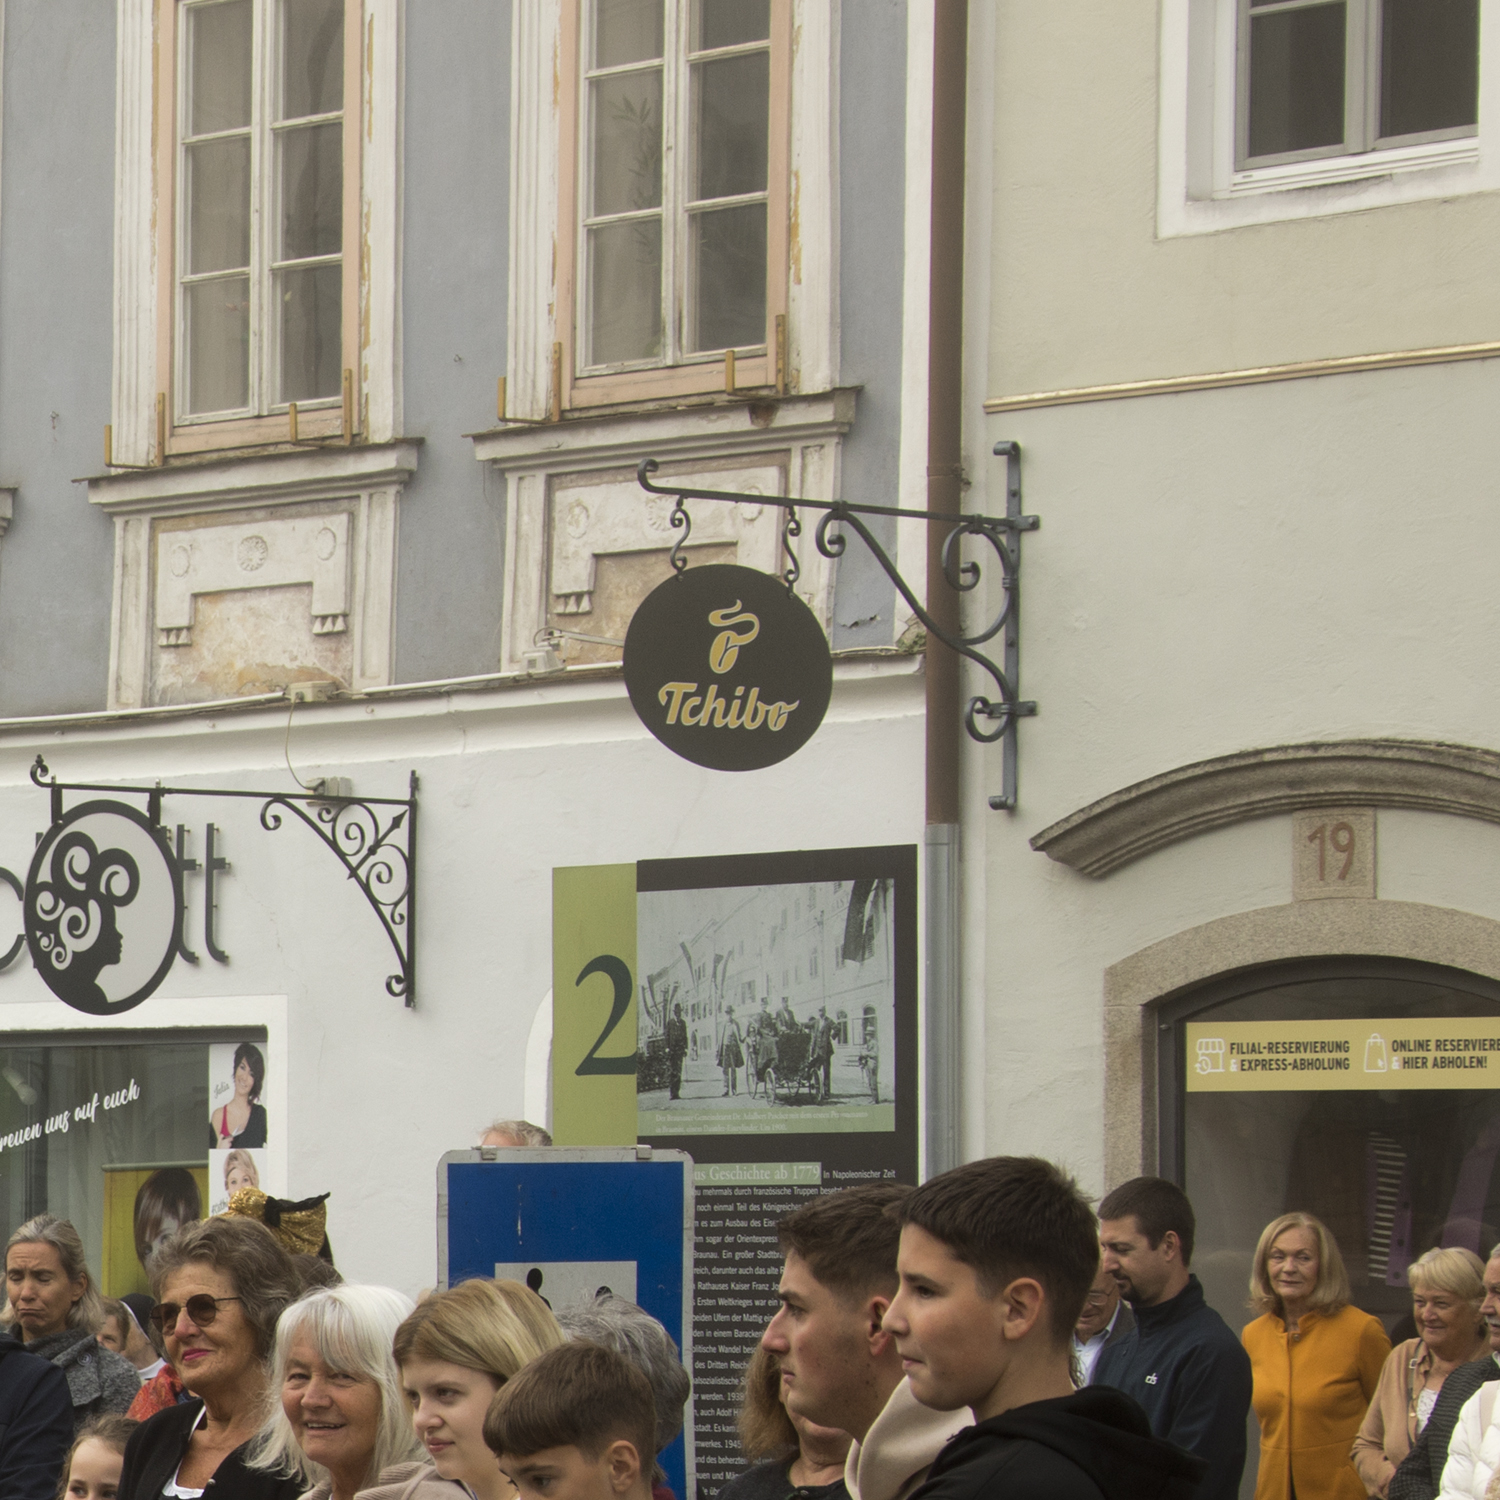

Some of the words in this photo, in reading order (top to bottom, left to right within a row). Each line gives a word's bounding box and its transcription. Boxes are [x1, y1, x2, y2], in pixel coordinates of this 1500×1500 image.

[658, 681, 800, 732] Tchibo
[1308, 821, 1356, 881] 19
[574, 954, 637, 1076] 2
[1230, 1040, 1350, 1055] FILIAL-RESERVIERUNG
[1391, 1039, 1432, 1052] ONLINE
[1240, 1057, 1350, 1072] EXPRESS-ABHOLUNG
[1402, 1056, 1428, 1070] HIER
[1432, 1055, 1488, 1070] ABHOLEN!
[44, 1110, 71, 1134] uns
[73, 1092, 100, 1123] auf
[102, 1078, 141, 1110] euch
[709, 1165, 771, 1181] Geschichte
[774, 1165, 788, 1180] ab
[793, 1165, 820, 1180] 1779
[832, 1169, 881, 1180] Napoleonischer
[883, 1169, 896, 1178] Zeit
[702, 1187, 733, 1196] mehrmals
[734, 1186, 752, 1196] durch
[753, 1186, 792, 1196] französische
[793, 1186, 818, 1196] Truppen
[696, 1203, 712, 1212] noch
[713, 1203, 734, 1212] einmal
[736, 1203, 747, 1212] Teil
[749, 1203, 761, 1212] des
[725, 1219, 748, 1228] Ausbau
[750, 1218, 761, 1227] des
[705, 1236, 722, 1245] sogar
[724, 1234, 735, 1243] der
[736, 1233, 778, 1244] Orientexpress
[722, 1250, 733, 1259] Ein
[735, 1250, 754, 1260] großer
[711, 1266, 738, 1275] darunter
[738, 1266, 753, 1275] auch
[754, 1266, 766, 1275] das
[767, 1266, 779, 1275] alte
[697, 1282, 729, 1291] Rathauses
[730, 1282, 750, 1291] Kaiser
[751, 1282, 769, 1291] Franz
[697, 1297, 716, 1306] Ersten
[718, 1297, 753, 1308] Weltkrieges
[755, 1298, 767, 1306] war
[731, 1313, 742, 1322] der
[743, 1313, 763, 1324] Mattig
[705, 1329, 712, 1337] in
[713, 1330, 733, 1338] einem
[718, 1345, 741, 1353] Wandel
[695, 1361, 706, 1369] des
[707, 1361, 729, 1369] Dritten
[700, 1408, 715, 1417] auch
[716, 1407, 732, 1417] Adolf
[713, 1423, 721, 1432] Es
